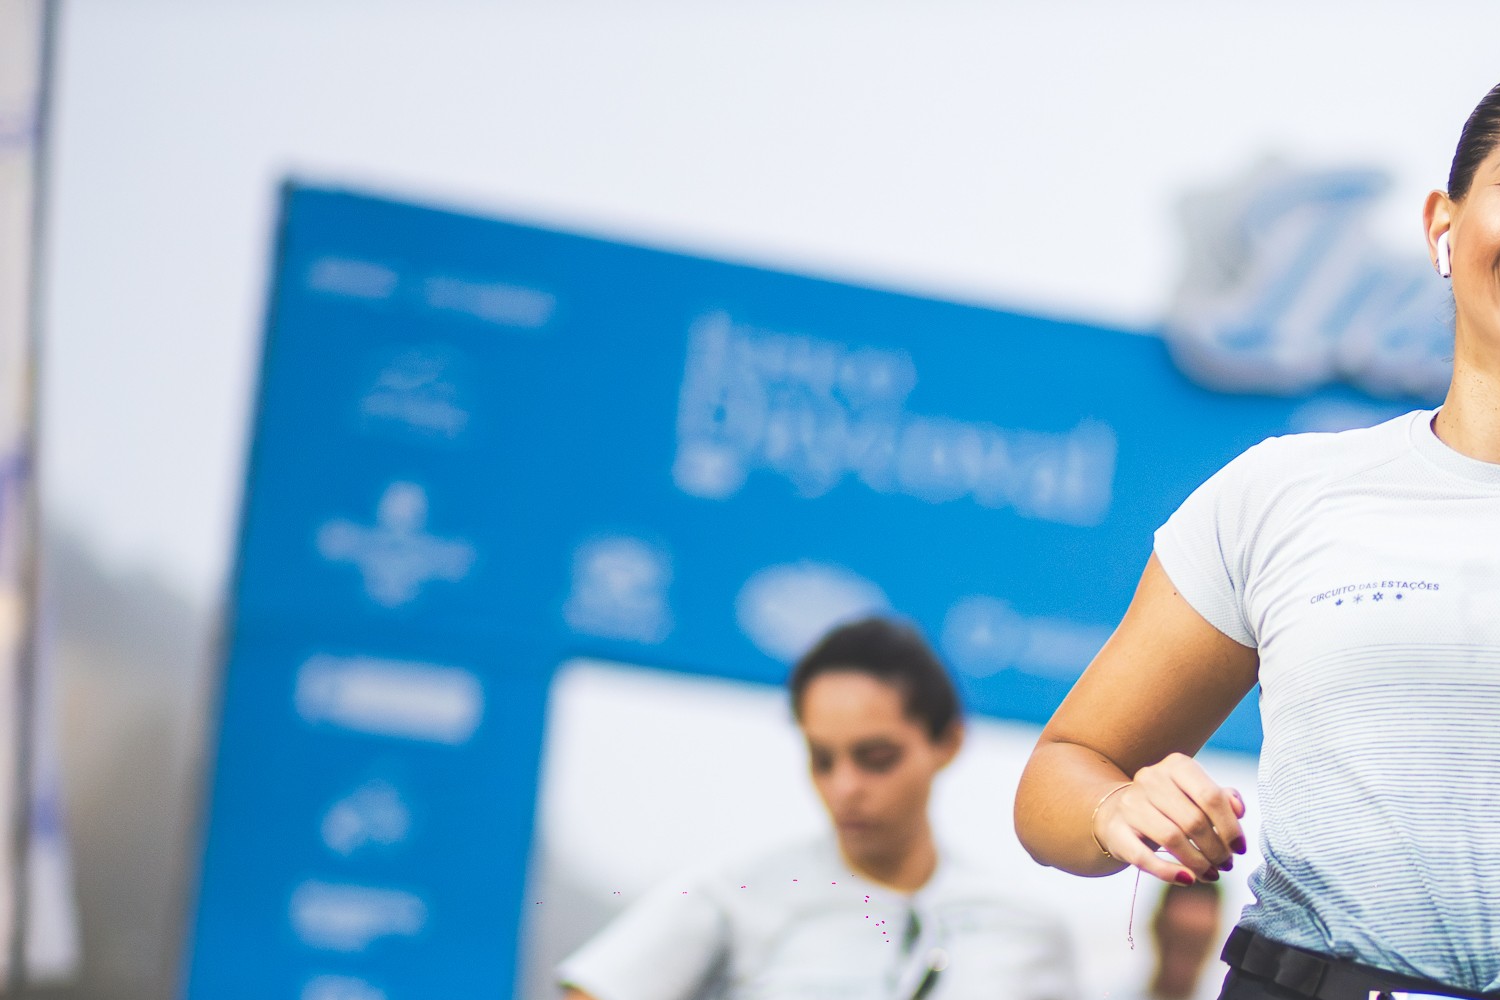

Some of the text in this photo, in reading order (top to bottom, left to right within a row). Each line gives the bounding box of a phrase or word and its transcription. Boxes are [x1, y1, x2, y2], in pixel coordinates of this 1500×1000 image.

[1310, 580, 1440, 604] CIRCUITO DAS ESTAÇÕES
